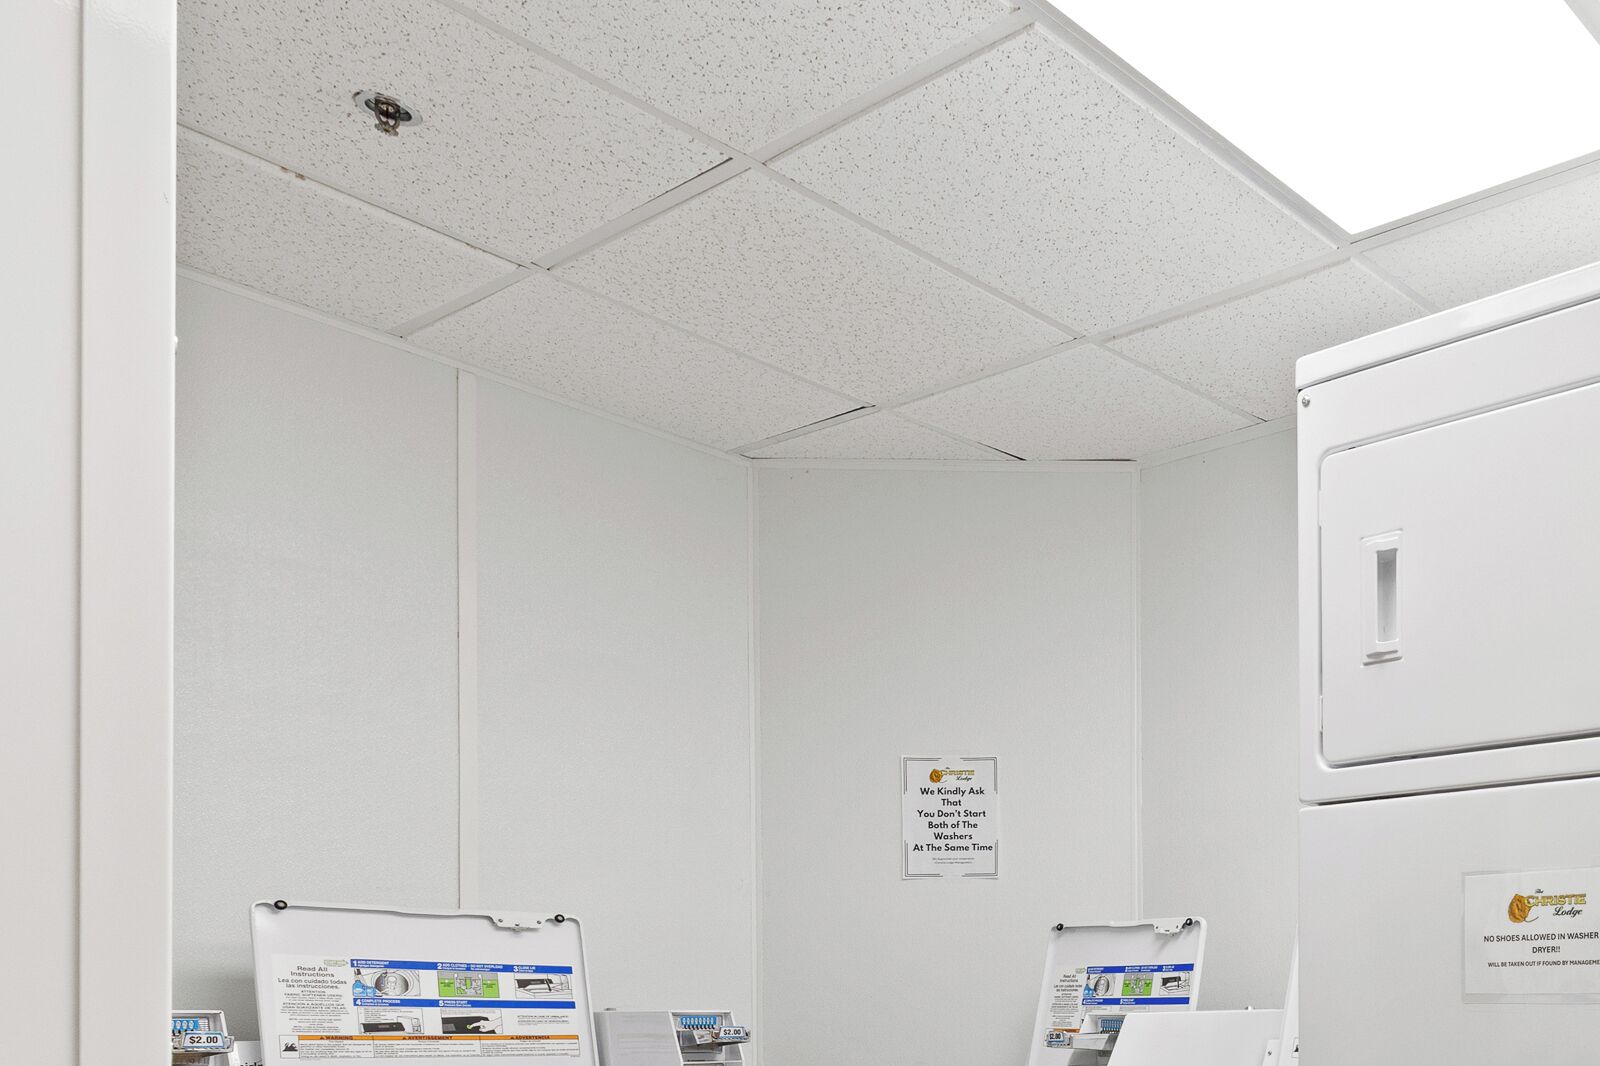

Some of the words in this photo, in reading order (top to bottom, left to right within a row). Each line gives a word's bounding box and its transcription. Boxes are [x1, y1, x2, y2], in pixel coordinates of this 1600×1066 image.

[937, 787, 966, 796] Kindly
[917, 809, 935, 817] You
[938, 809, 960, 817] Don't
[963, 809, 986, 817] Start
[1524, 893, 1586, 907] CHRISTIE
[1553, 906, 1583, 917] Lodge
[189, 1036, 218, 1044] $2.00
